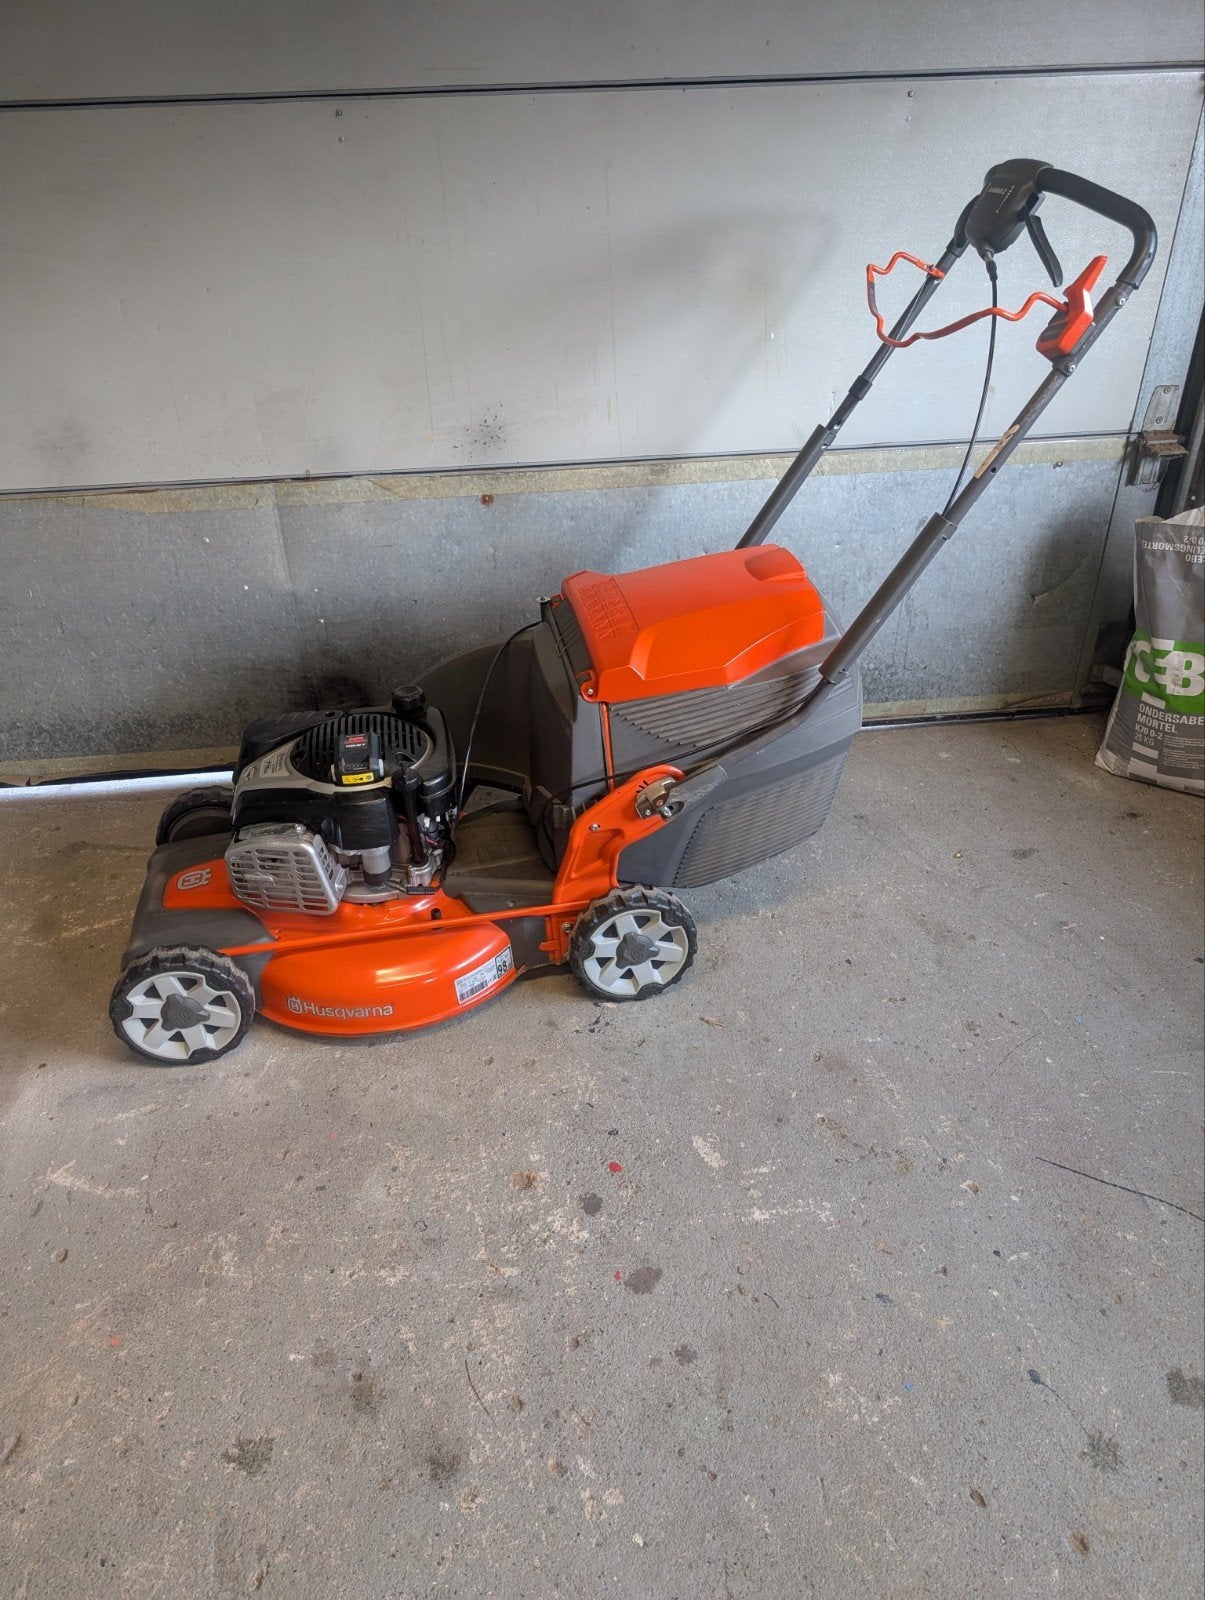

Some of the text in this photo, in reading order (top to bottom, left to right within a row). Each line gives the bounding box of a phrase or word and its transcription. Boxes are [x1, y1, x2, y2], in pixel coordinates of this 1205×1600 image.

[1137, 713, 1178, 734] MORTEL
[1139, 703, 1205, 726] ONDERSABE
[1134, 733, 1143, 742] 25
[1144, 737, 1155, 746] KG
[1135, 723, 1163, 740] K70 0-2
[497, 960, 507, 978] 98
[303, 1001, 394, 1020] Husqvarna
